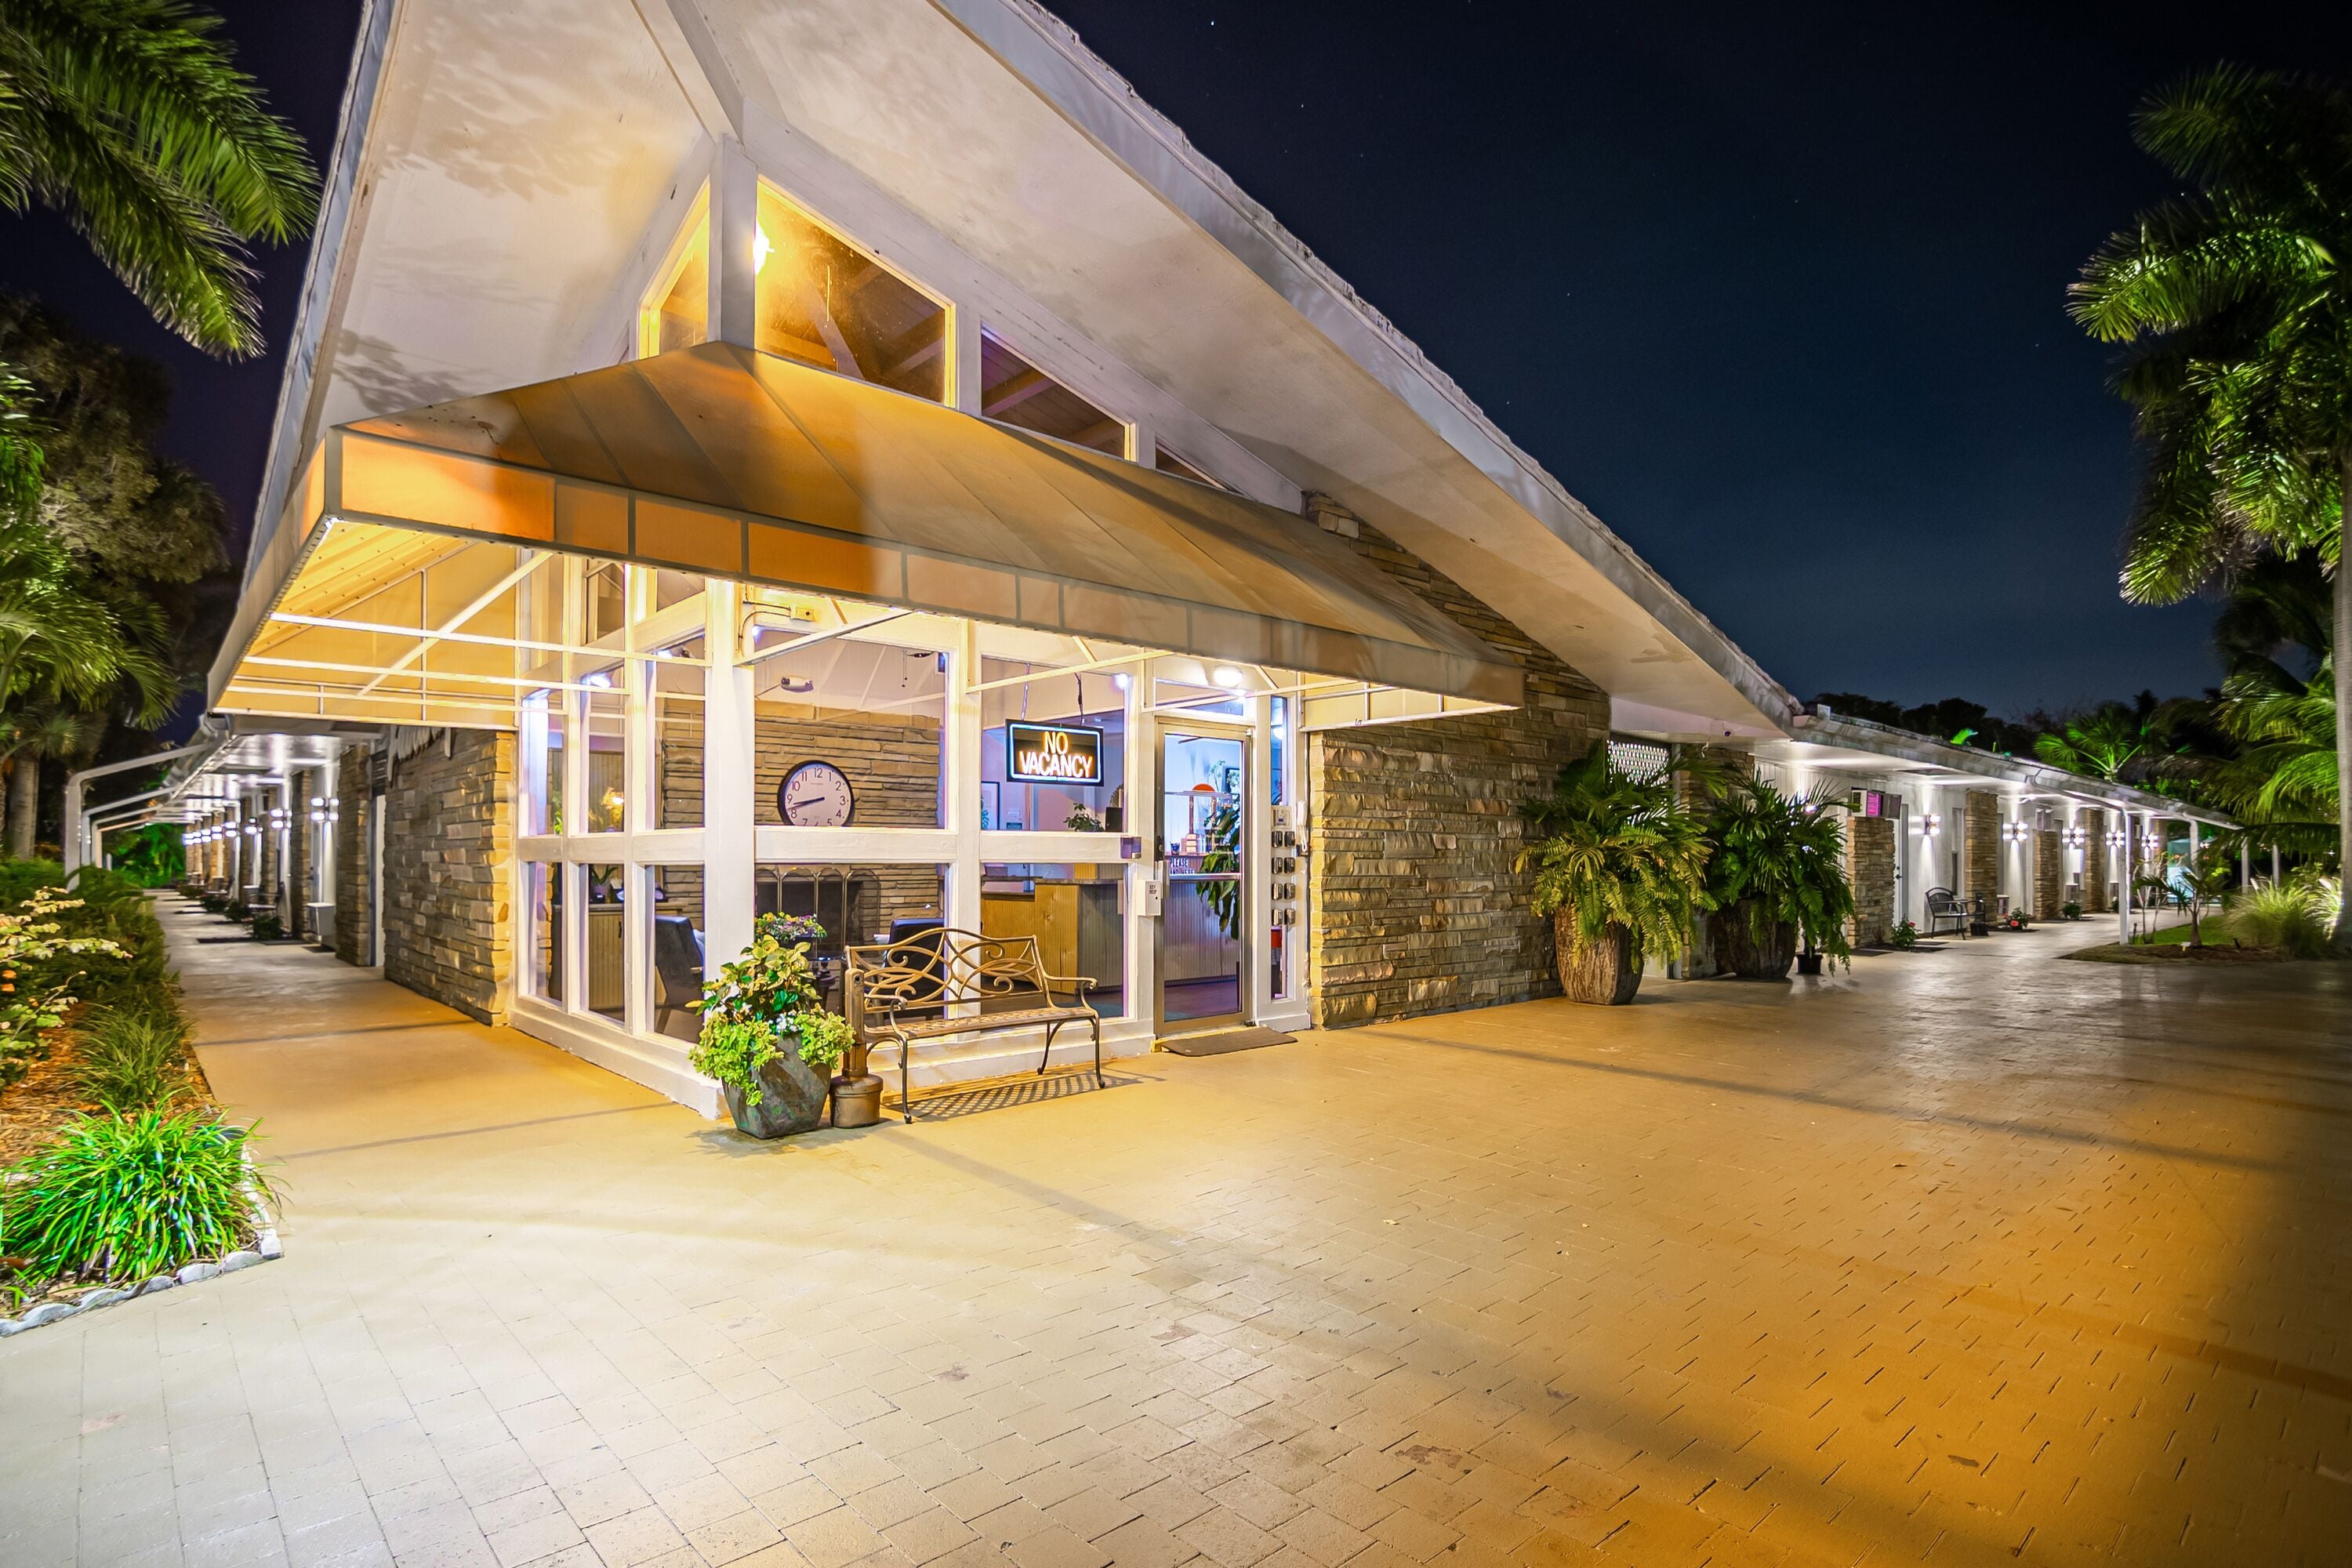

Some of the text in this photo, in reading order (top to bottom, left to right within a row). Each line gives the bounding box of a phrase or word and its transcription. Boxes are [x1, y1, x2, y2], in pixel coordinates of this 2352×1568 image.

[1044, 731, 1068, 754] NO
[1019, 750, 1092, 778] VACANCY
[802, 771, 808, 782] 11
[814, 768, 822, 778] 12
[792, 781, 800, 791] 10
[835, 781, 842, 791] 2
[786, 793, 793, 804] 9
[840, 796, 846, 806] 3
[790, 808, 797, 818] 8
[836, 809, 842, 818] 4
[1170, 858, 1188, 868] PLEASE
